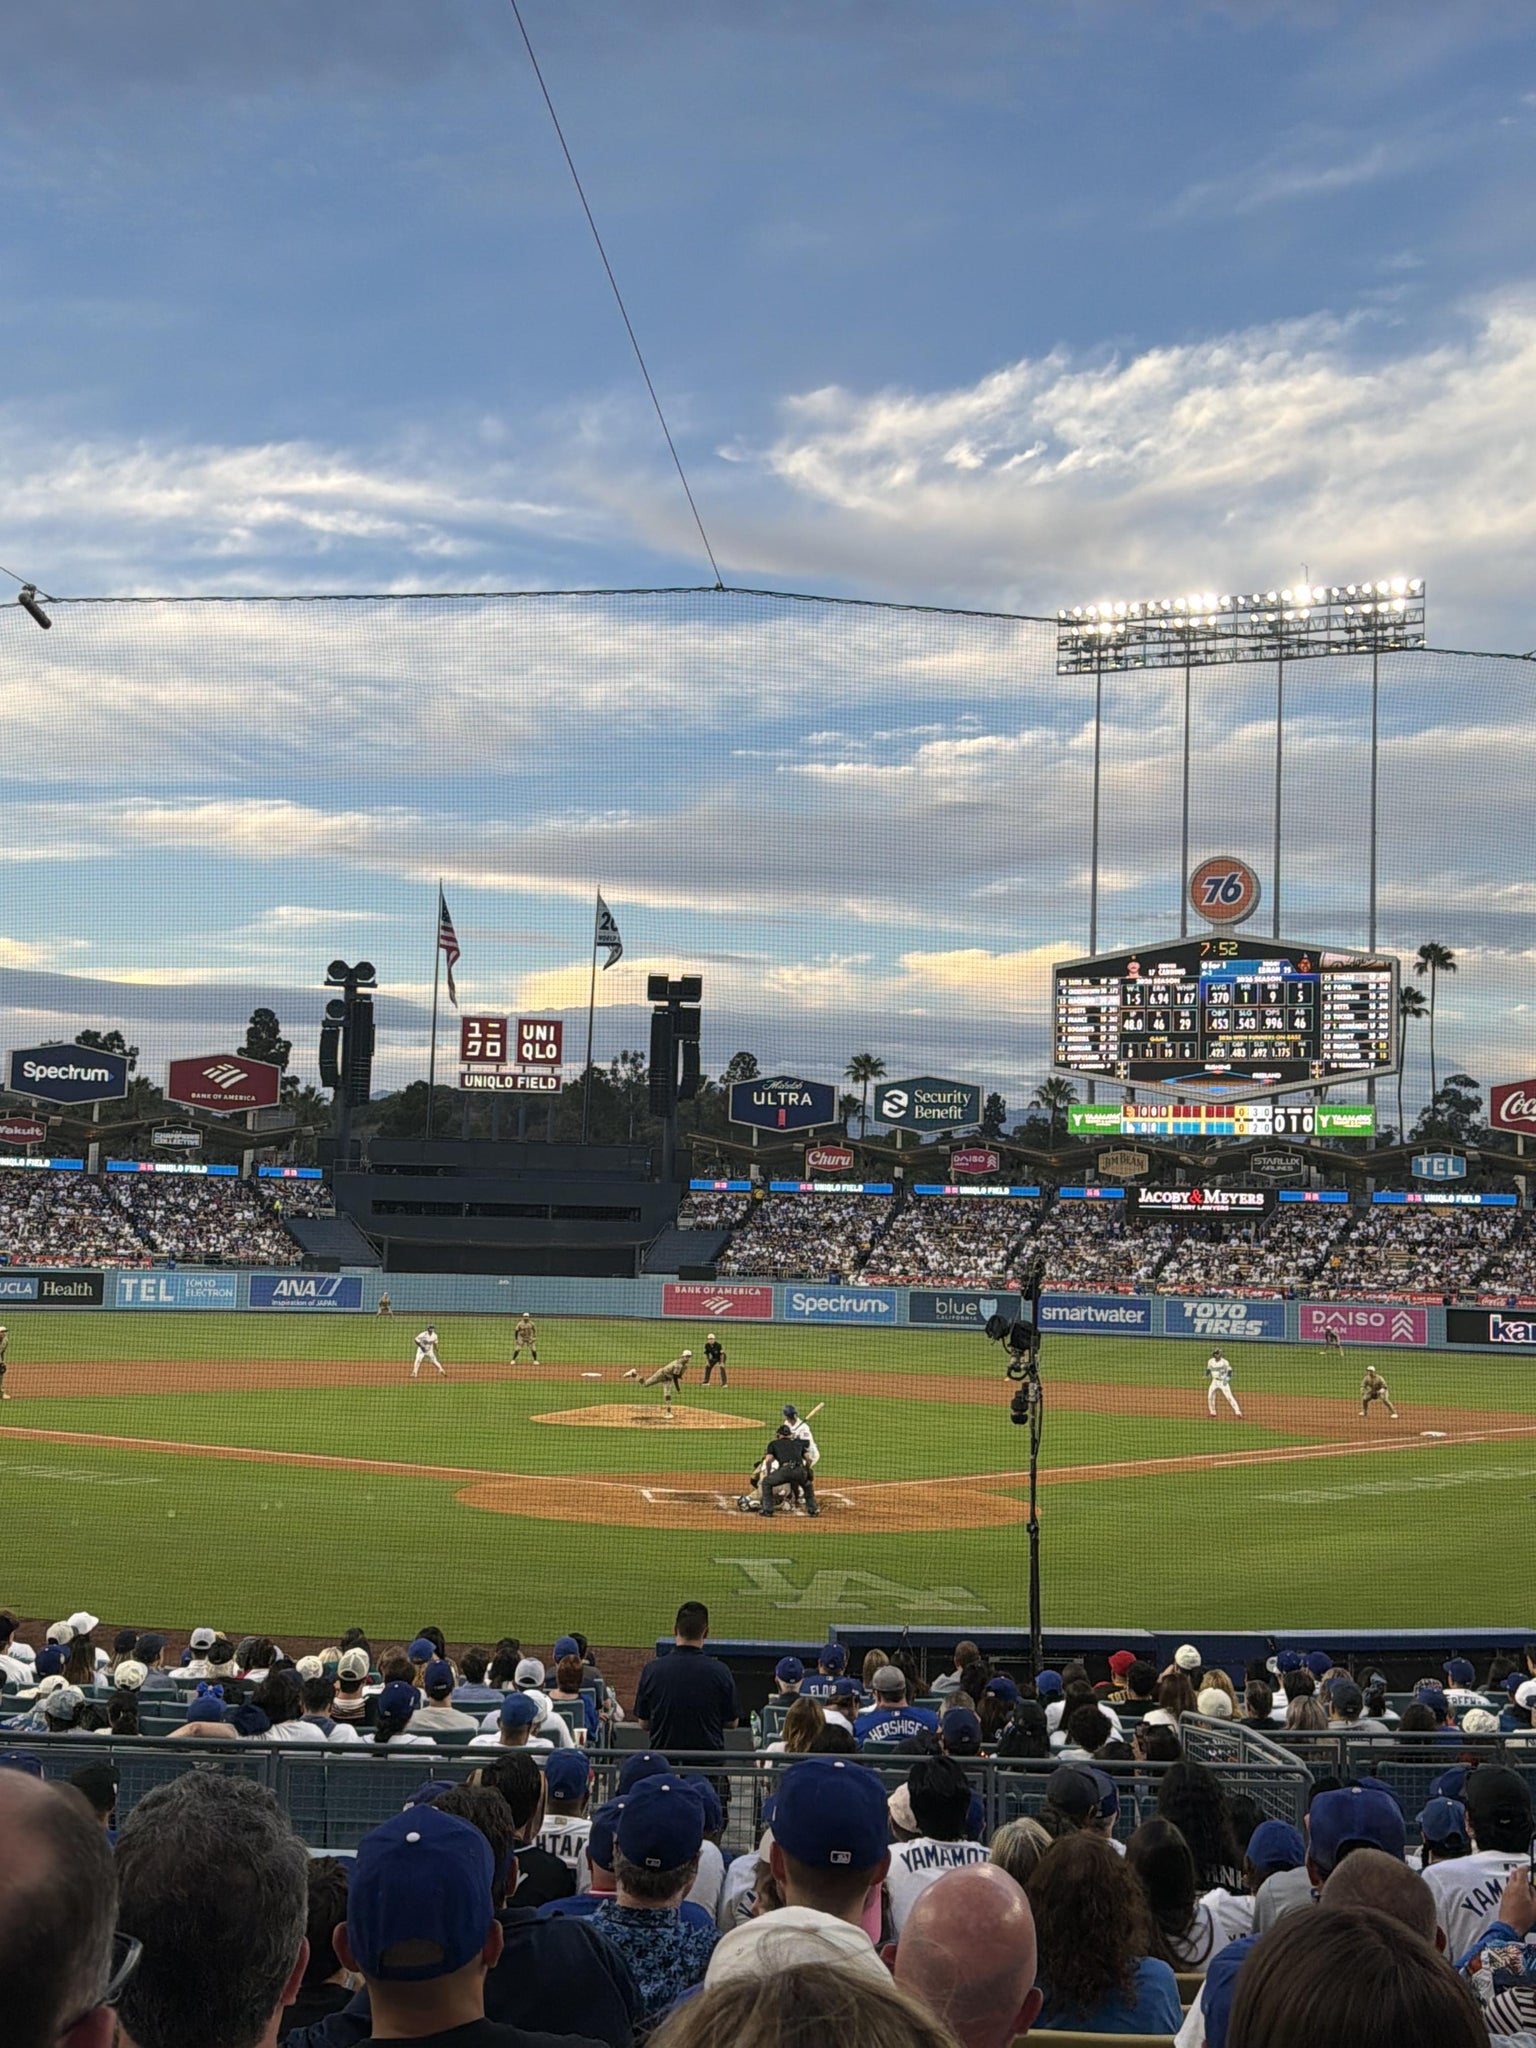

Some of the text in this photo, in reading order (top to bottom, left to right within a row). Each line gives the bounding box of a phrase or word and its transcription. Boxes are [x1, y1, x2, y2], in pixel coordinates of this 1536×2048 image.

[1200, 872, 1245, 905] 76
[1200, 941, 1238, 956] 7:52
[1150, 993, 1169, 1004] 6.94
[1176, 993, 1195, 1004] 1.67
[1209, 991, 1304, 1004] .370 1 9 5
[467, 1022, 501, 1038] ユニ
[1123, 1019, 1143, 1030] 48.0
[1154, 1019, 1164, 1030] 46
[1180, 1019, 1191, 1030] 29
[1209, 1018, 1306, 1030] .453 .543 .996 46
[522, 1024, 554, 1040] UNI
[466, 1041, 501, 1057] クロ
[522, 1044, 557, 1060] QLO
[1146, 1049, 1153, 1057] 11
[1165, 1049, 1173, 1057] 19
[1251, 1048, 1267, 1057] .692
[1272, 1048, 1290, 1057] 1.175
[1300, 1048, 1304, 1056] 1
[23, 1061, 110, 1083] Spectrum
[464, 1074, 556, 1090] UNIQLO FIELD
[191, 1092, 211, 1100] BANK
[753, 1092, 813, 1106] ULTRA
[914, 1089, 972, 1107] Security
[914, 1105, 964, 1120] Benefit
[1252, 1108, 1258, 1116] 3
[1264, 1108, 1269, 1116] 0
[1252, 1124, 1258, 1132] 2
[1264, 1124, 1269, 1132] 0
[1275, 1115, 1285, 1133] 0
[1291, 1116, 1296, 1132] 1
[1303, 1115, 1313, 1132] 0
[808, 1151, 851, 1166] Churu
[954, 1155, 985, 1163] DAISO
[1102, 1152, 1144, 1170] JIM BEAM
[1254, 1157, 1300, 1165] STARLUX
[1418, 1158, 1460, 1176] TEL
[1138, 1188, 1264, 1205] JACOBY & MEYERS
[1424, 1194, 1481, 1204] UNIQLO FIELD
[0, 1281, 94, 1296] UCLA Health
[121, 1279, 174, 1302] TEL
[186, 1279, 216, 1288] TOKYO
[272, 1279, 316, 1297] ANA
[675, 1286, 761, 1296] BANK OF AMERICA
[186, 1289, 233, 1297] ELECTRON
[792, 1293, 883, 1316] Spectrum
[936, 1297, 978, 1315] blue
[1183, 1302, 1248, 1319] TOYO
[1042, 1306, 1145, 1324] smartwater
[1312, 1310, 1385, 1326] DAISO
[1192, 1318, 1264, 1336] TIRES
[1312, 1326, 1347, 1334] JAAN
[868, 1720, 928, 1741] HERSHISE
